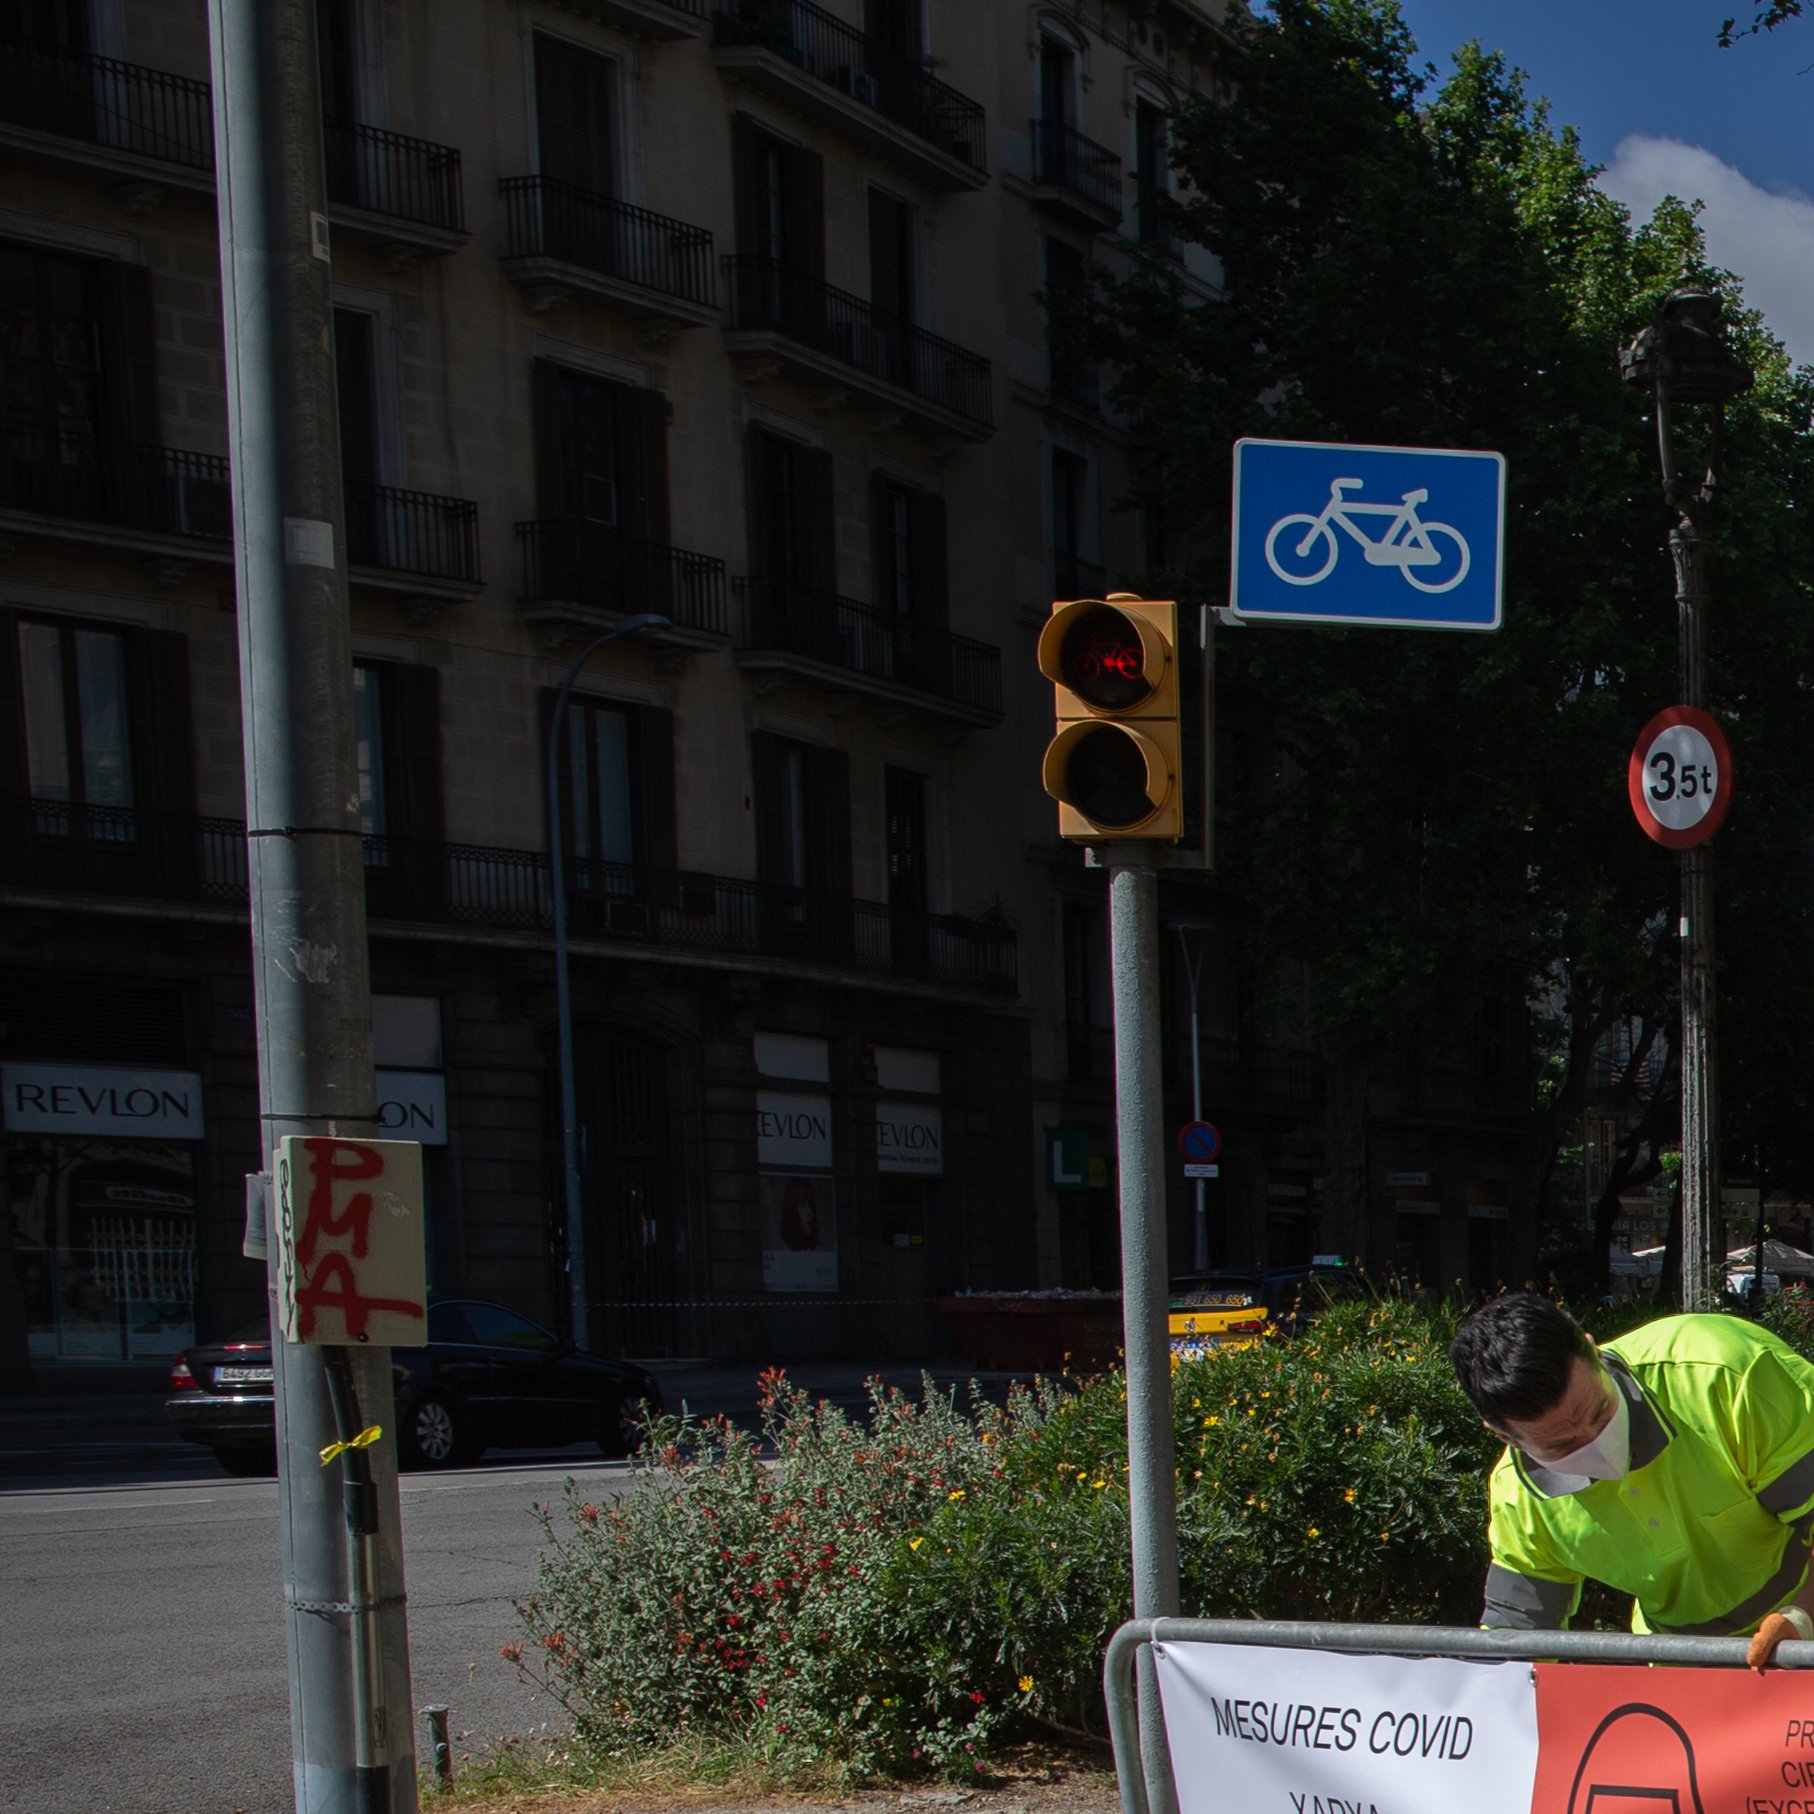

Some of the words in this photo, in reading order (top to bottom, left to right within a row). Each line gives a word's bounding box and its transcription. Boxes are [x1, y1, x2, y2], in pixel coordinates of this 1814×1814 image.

[16, 1083, 189, 1118] REVLON
[1053, 1140, 1082, 1184] L
[1211, 1697, 1361, 1751] MESURES
[1369, 1710, 1473, 1760] COVID
